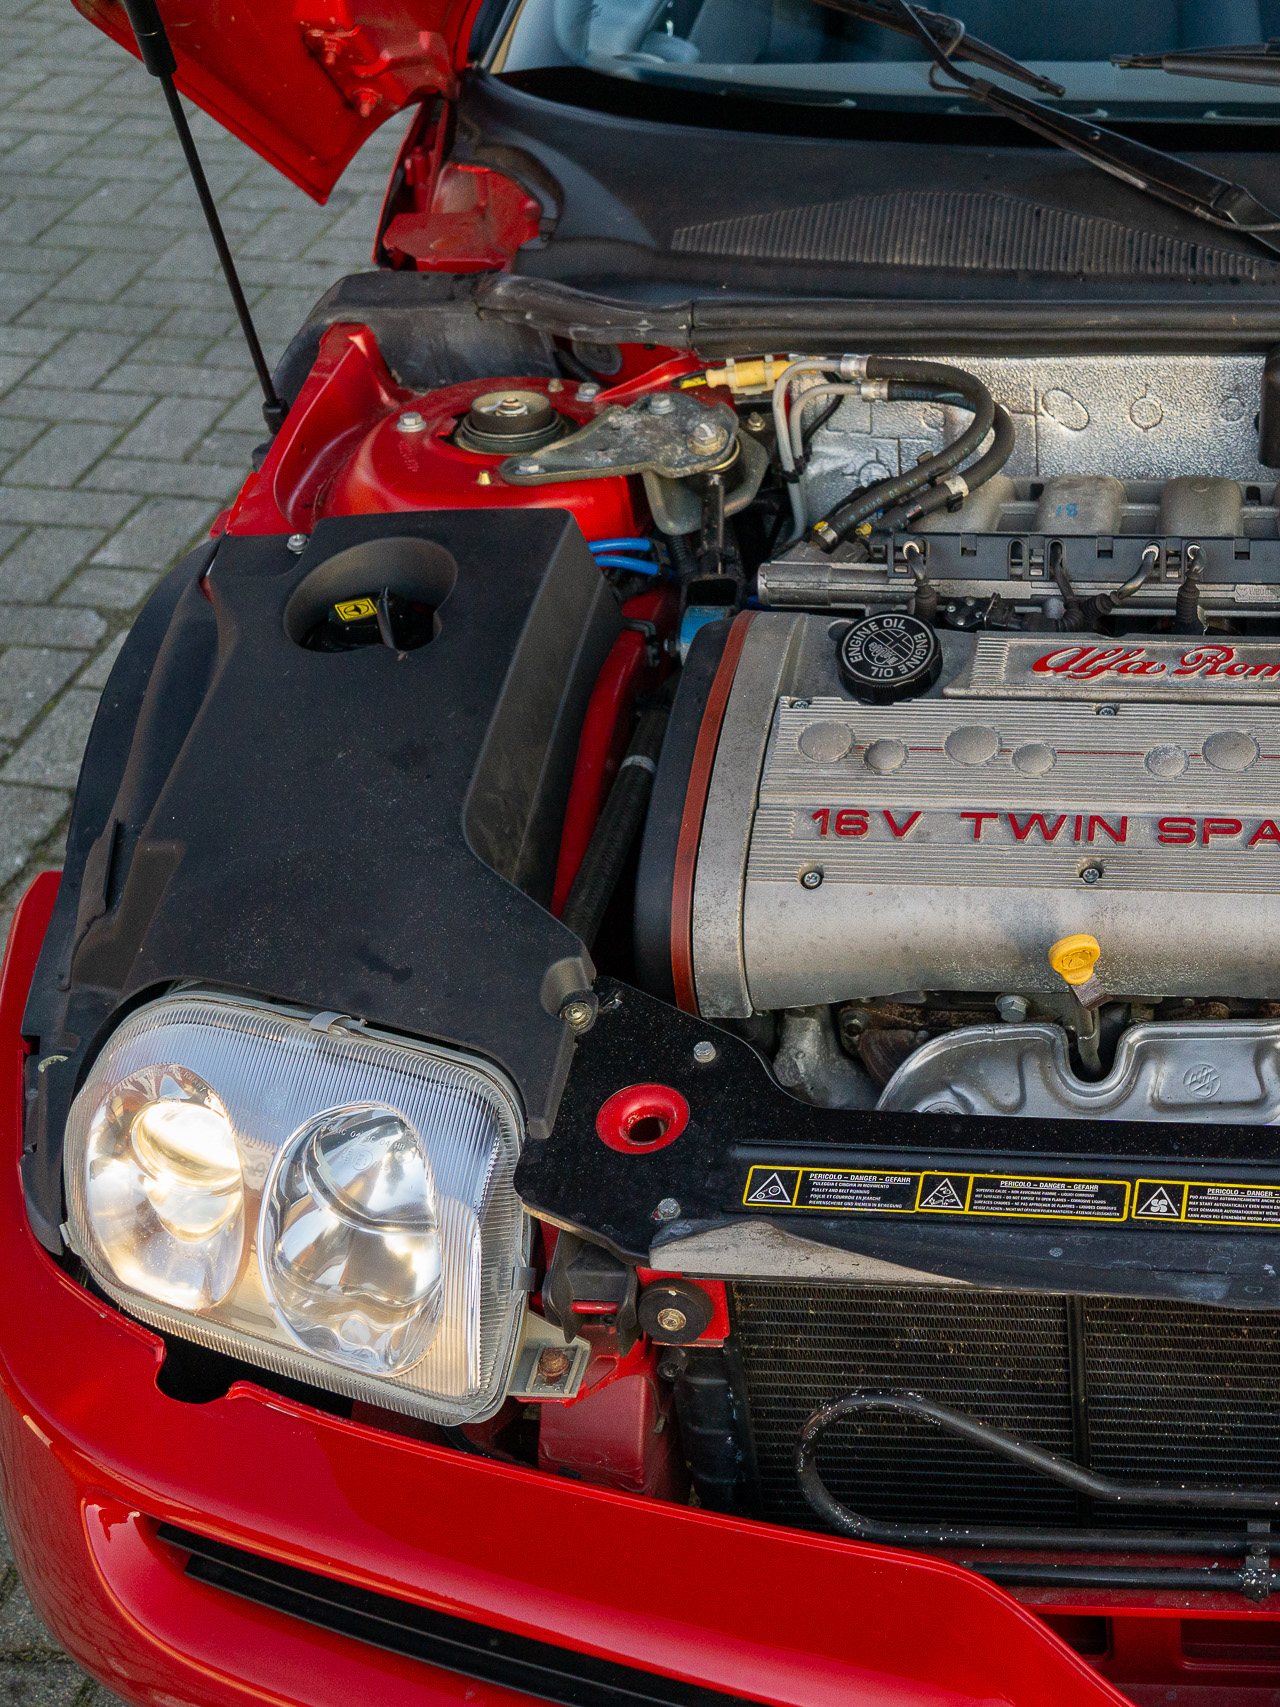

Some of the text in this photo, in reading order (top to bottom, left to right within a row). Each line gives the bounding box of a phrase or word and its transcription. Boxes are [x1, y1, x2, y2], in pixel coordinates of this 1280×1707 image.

[848, 618, 906, 663] ENGINE OIL
[871, 632, 928, 678] ENGINE OIL
[1032, 646, 1168, 681] Alfa
[960, 811, 1128, 847] TWIN
